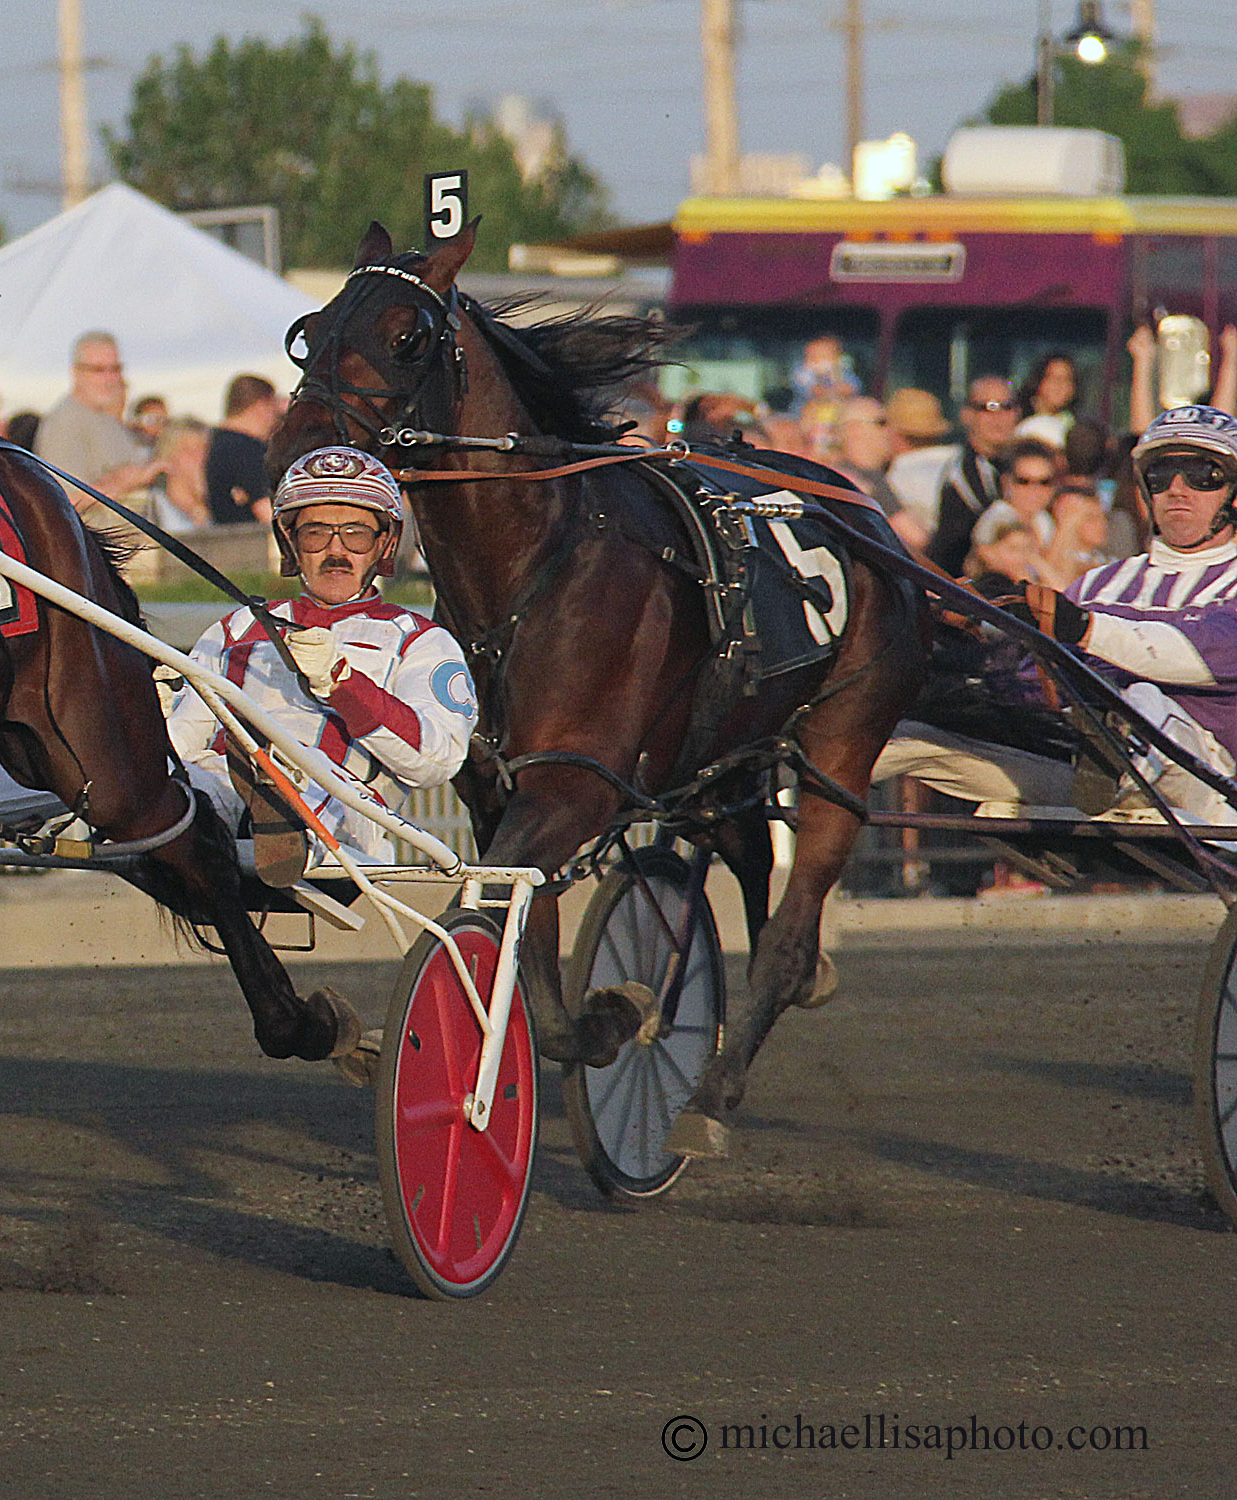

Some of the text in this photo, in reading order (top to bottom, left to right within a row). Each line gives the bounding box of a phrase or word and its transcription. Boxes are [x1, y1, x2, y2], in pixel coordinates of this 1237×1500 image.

[431, 175, 462, 239] 5
[751, 489, 849, 647] 5
[428, 658, 476, 721] C
